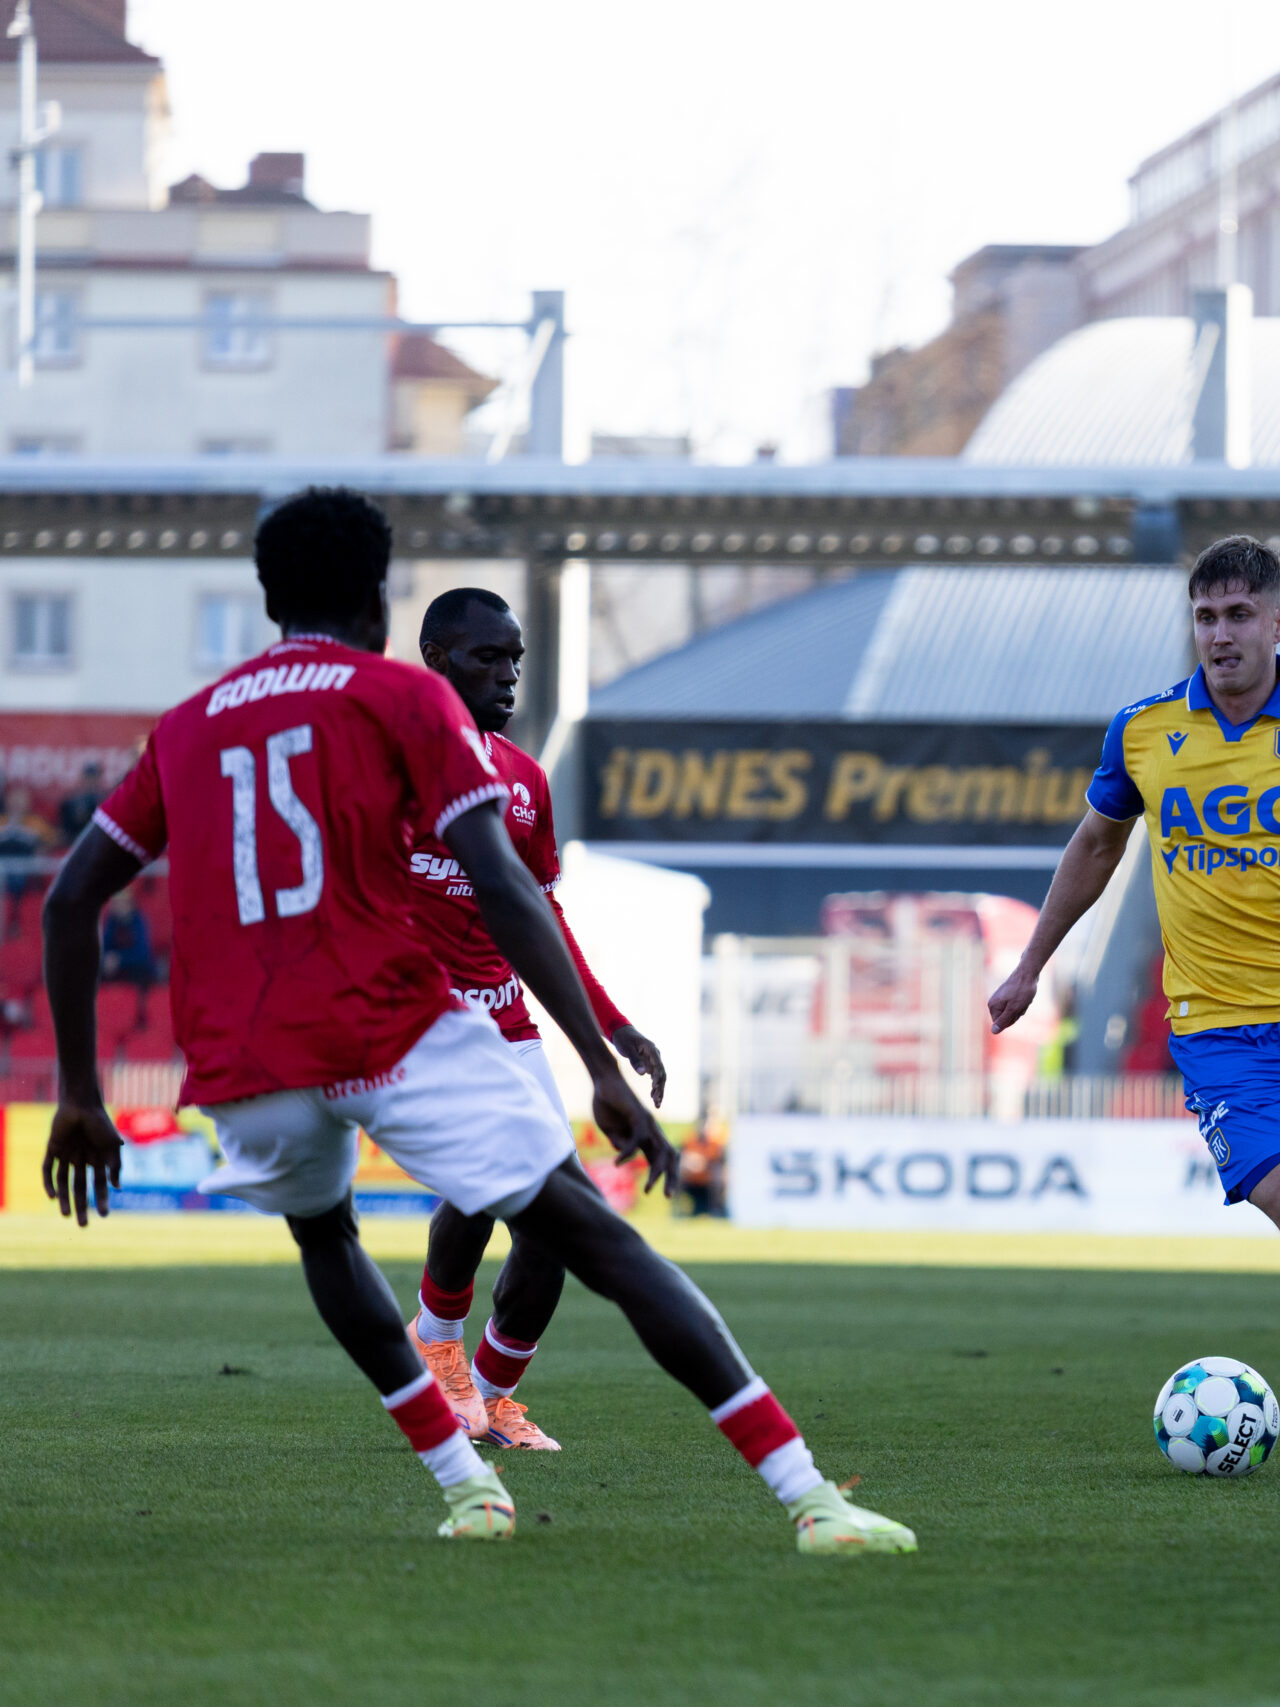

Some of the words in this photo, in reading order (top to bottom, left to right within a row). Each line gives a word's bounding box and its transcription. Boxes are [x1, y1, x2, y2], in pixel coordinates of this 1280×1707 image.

[206, 662, 357, 717] GODWIN
[512, 805, 536, 822] CH&T
[602, 748, 813, 820] iDNES
[221, 724, 324, 925] 15
[1218, 1413, 1257, 1474] SELECT
